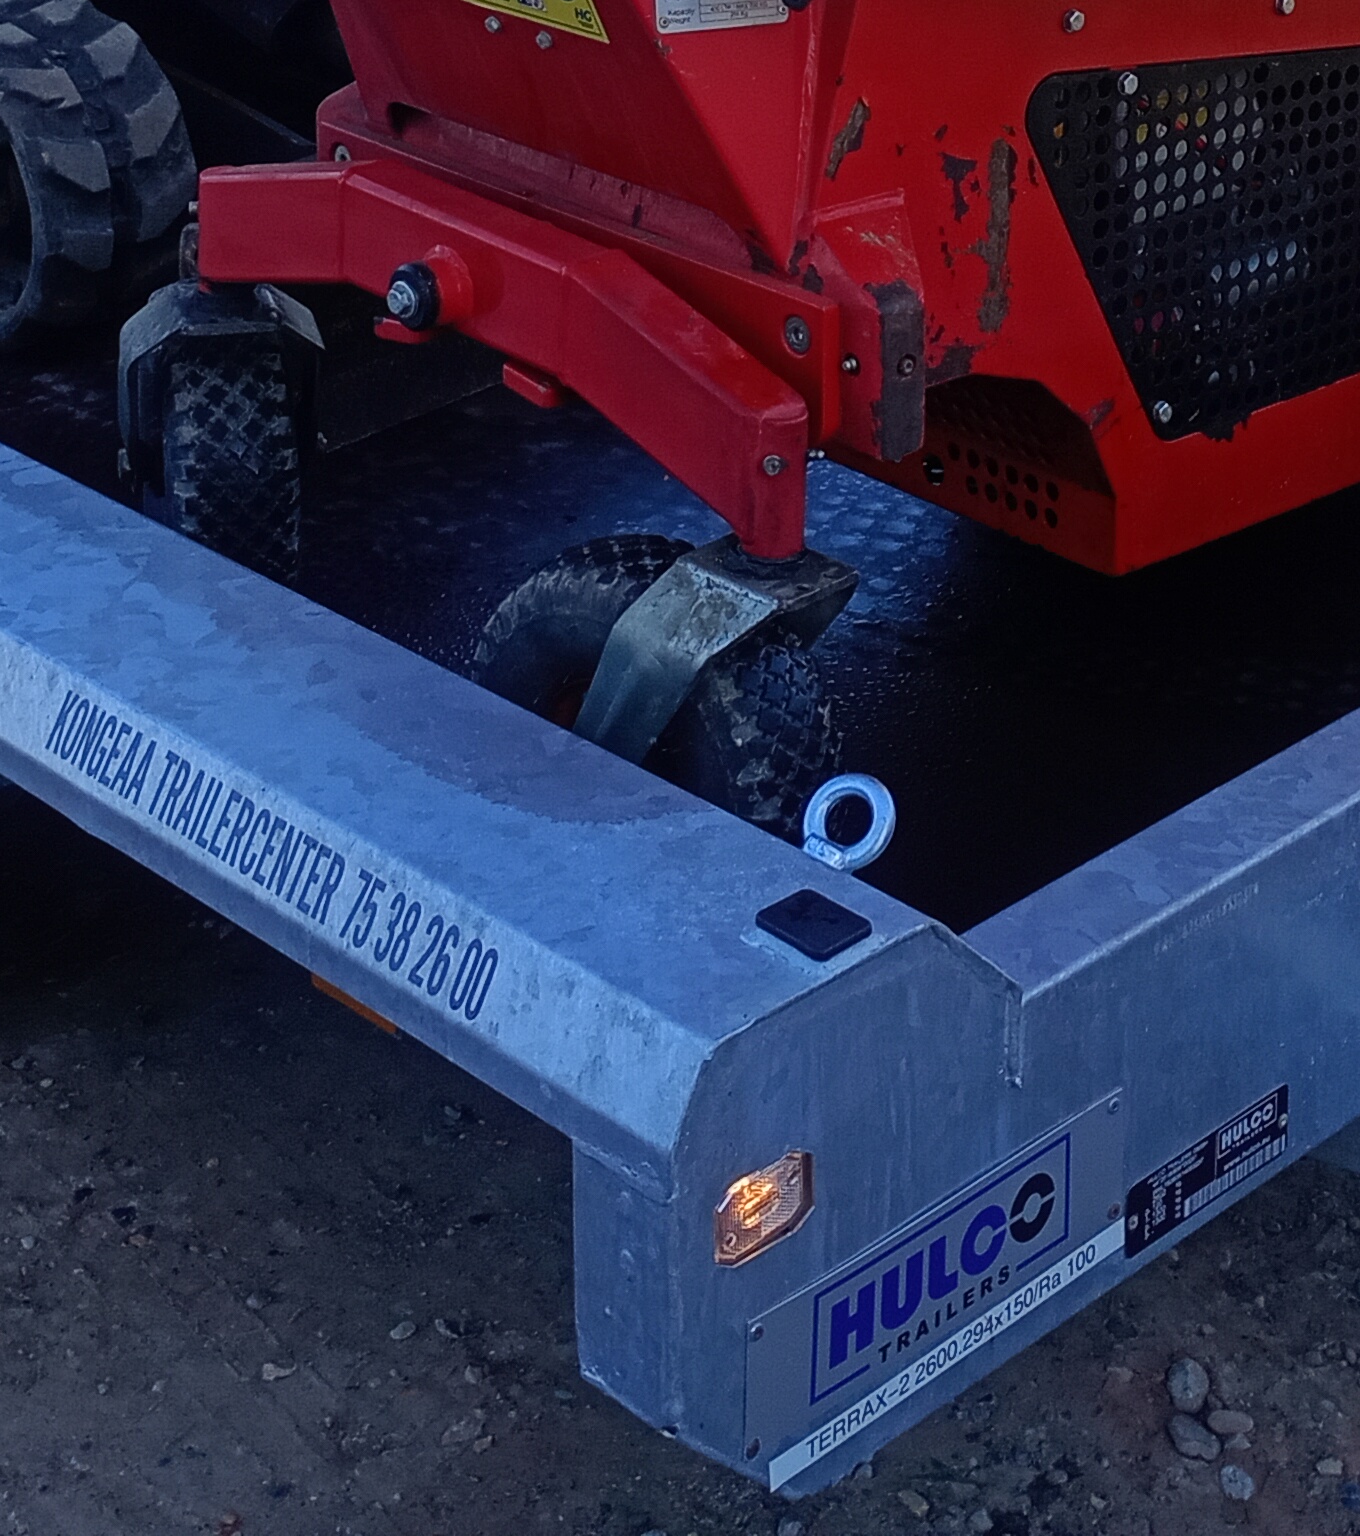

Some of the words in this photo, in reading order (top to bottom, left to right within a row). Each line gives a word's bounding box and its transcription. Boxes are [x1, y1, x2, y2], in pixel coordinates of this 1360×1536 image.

[575, 8, 593, 22] HG
[45, 690, 157, 805] KONGEAA
[148, 750, 346, 926] TRAILERCENTER
[340, 868, 386, 948] 75
[374, 892, 422, 972] 38
[408, 915, 460, 996] 26
[449, 938, 499, 1020] 00
[1220, 1102, 1274, 1151] HULCO
[828, 1172, 1055, 1371] HULCO
[878, 1265, 1011, 1364] TRAILERS
[806, 1372, 910, 1459] TERRAX-2
[914, 1273, 1062, 1384] 2600.294x150/Ra
[1067, 1244, 1097, 1278] 100
